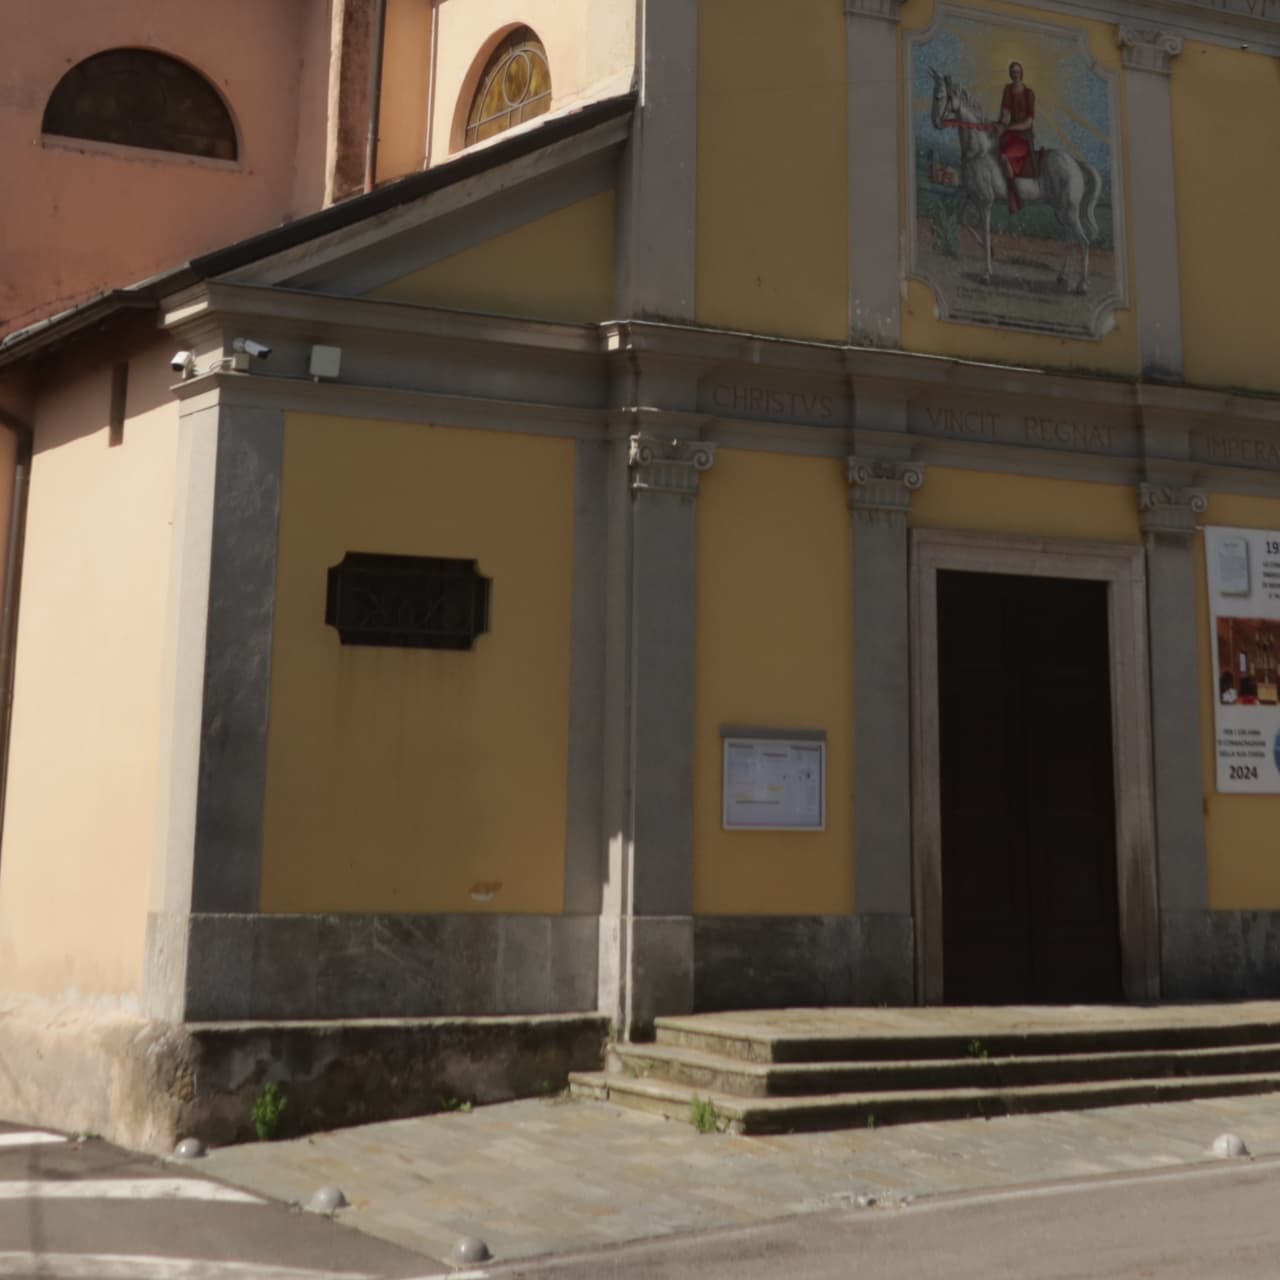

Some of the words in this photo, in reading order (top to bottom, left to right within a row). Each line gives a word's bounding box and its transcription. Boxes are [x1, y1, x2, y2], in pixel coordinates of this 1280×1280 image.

[713, 383, 833, 419] CHRISTVS
[927, 407, 1001, 436] VINCIT
[1023, 415, 1116, 449] REGNAT
[1229, 765, 1259, 780] 2024
